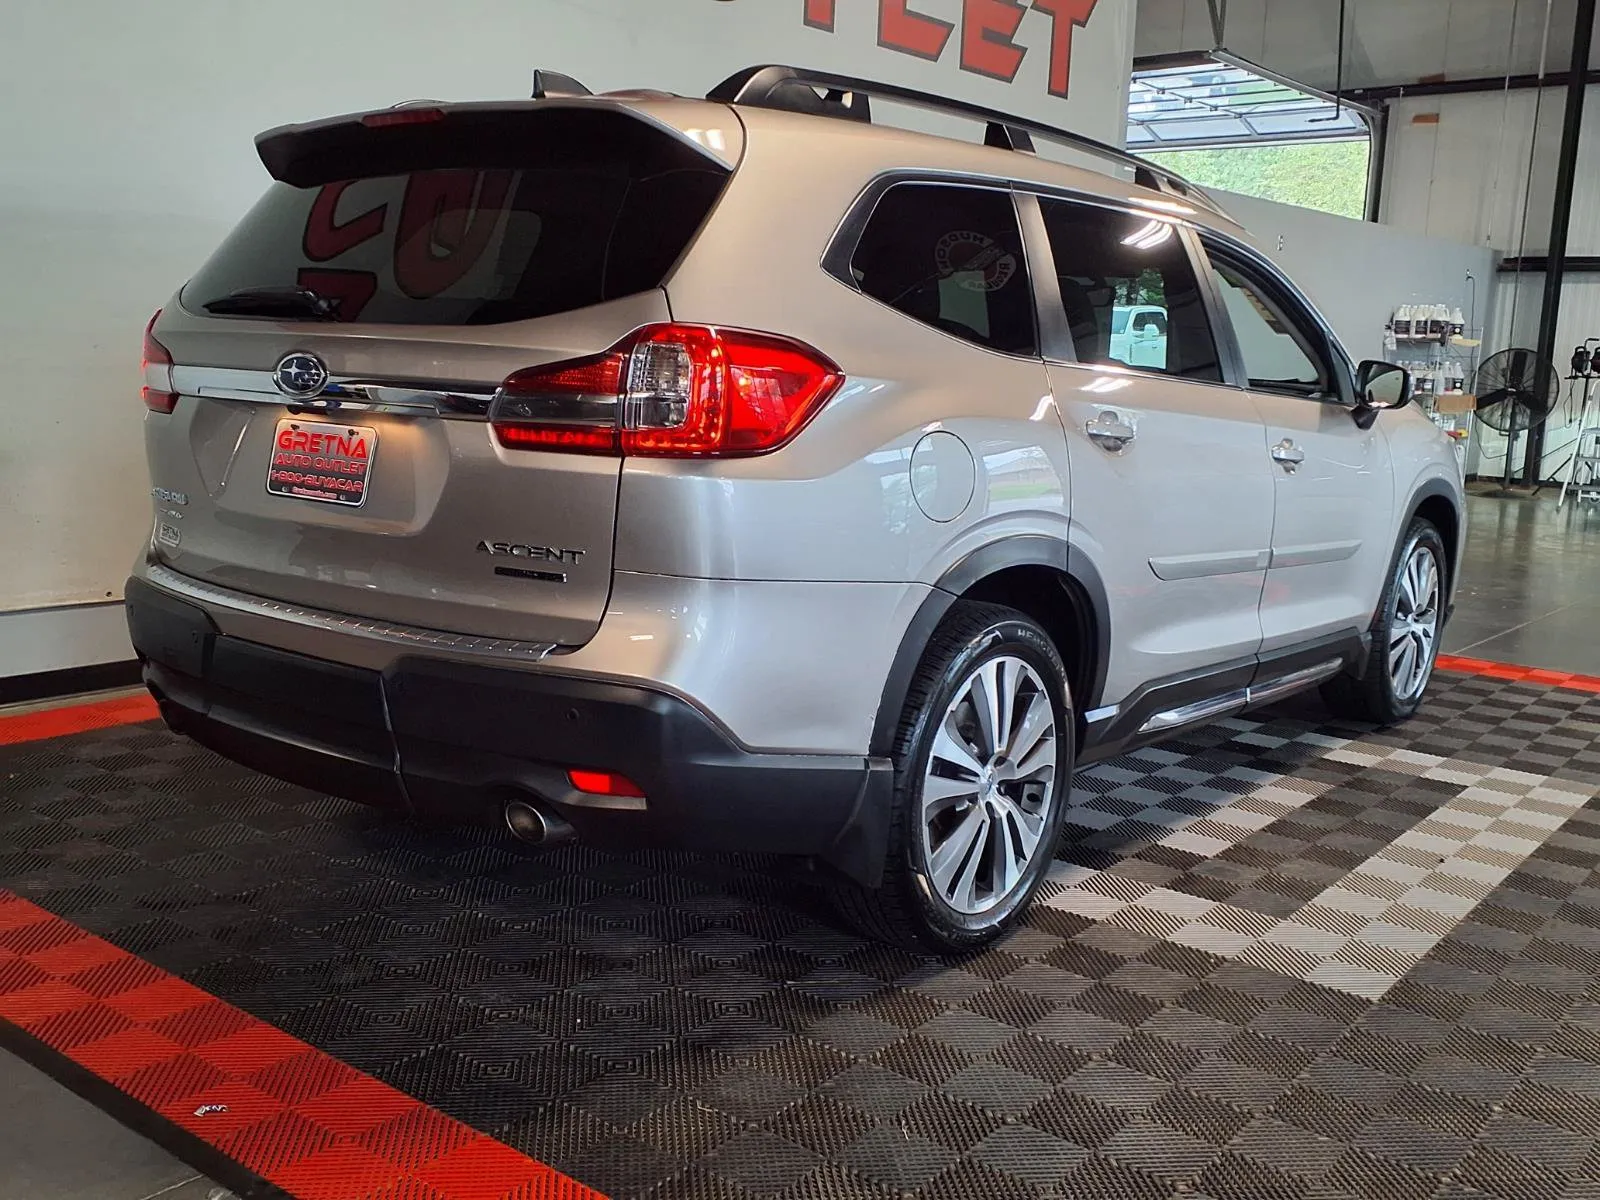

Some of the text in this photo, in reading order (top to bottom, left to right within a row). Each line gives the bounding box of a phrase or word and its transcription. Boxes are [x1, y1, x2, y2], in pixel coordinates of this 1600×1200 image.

[278, 430, 367, 459] GRETNA
[275, 453, 367, 475] AUTO OUTLET
[477, 540, 586, 564] ASCENT
